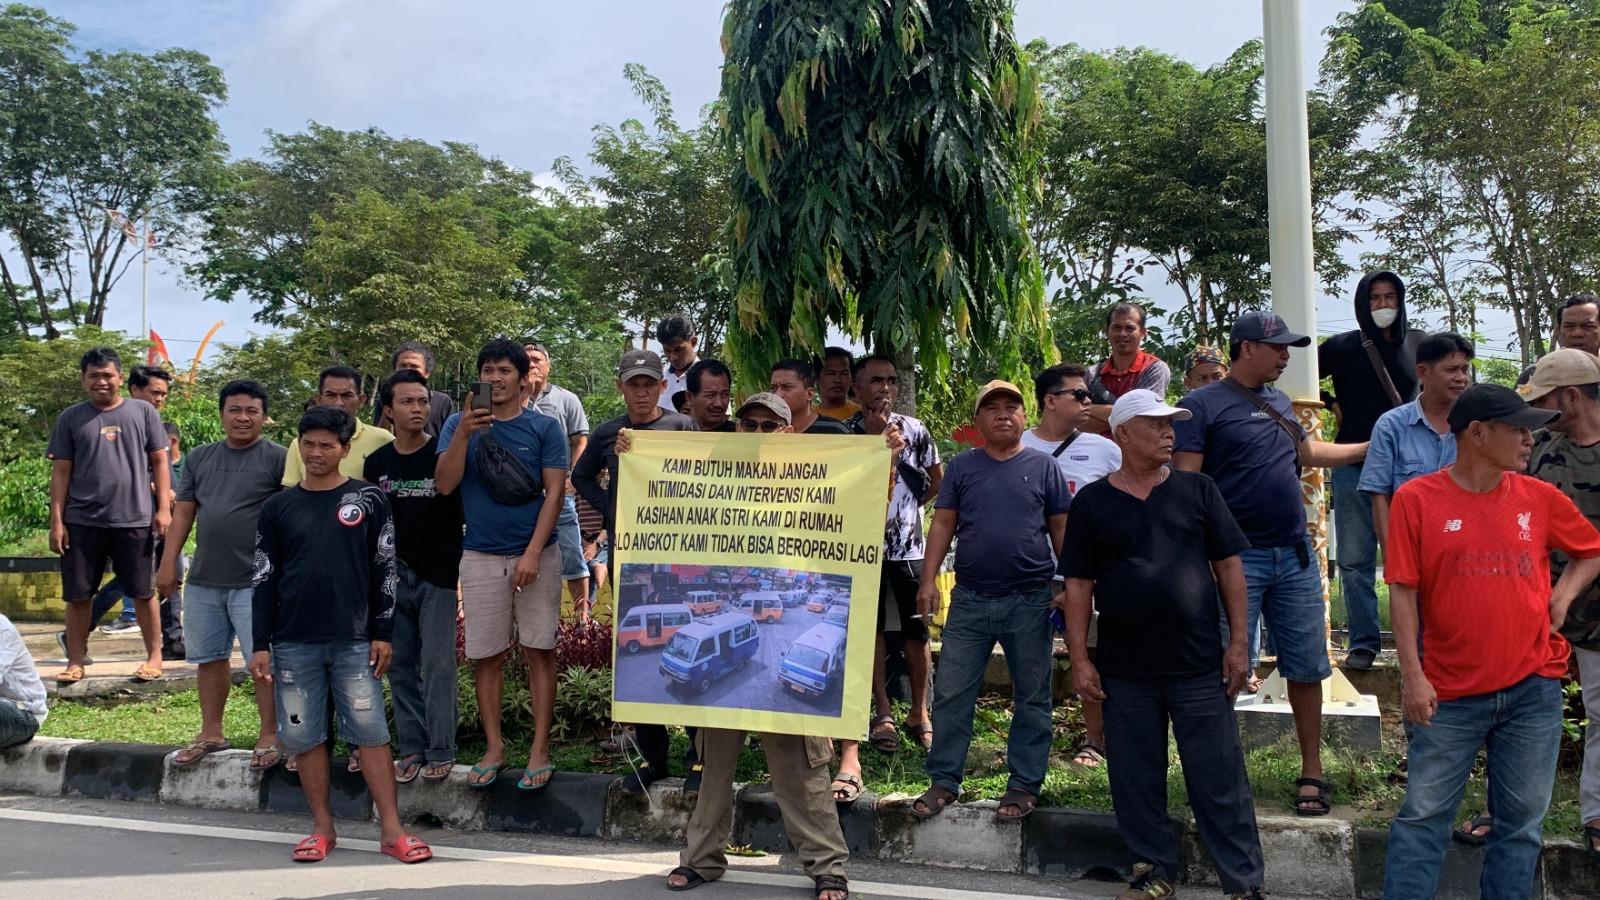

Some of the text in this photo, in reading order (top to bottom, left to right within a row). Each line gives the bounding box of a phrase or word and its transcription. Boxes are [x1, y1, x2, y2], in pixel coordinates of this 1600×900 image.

[662, 458, 828, 480] KAMI BUTUH MAKAN JANGAN
[648, 480, 836, 505] INTIMIDASI DAN INTERVENSI KAMI
[636, 506, 844, 533] KASIHAN ANAK ISTRI KAMI DI RUMAH
[631, 532, 678, 551] ANGKOT
[680, 533, 708, 552] KAMI
[711, 534, 745, 553] TIDAK
[747, 535, 775, 554] BISA
[777, 536, 847, 562] BEROPRASI
[849, 543, 879, 565] LAGI
